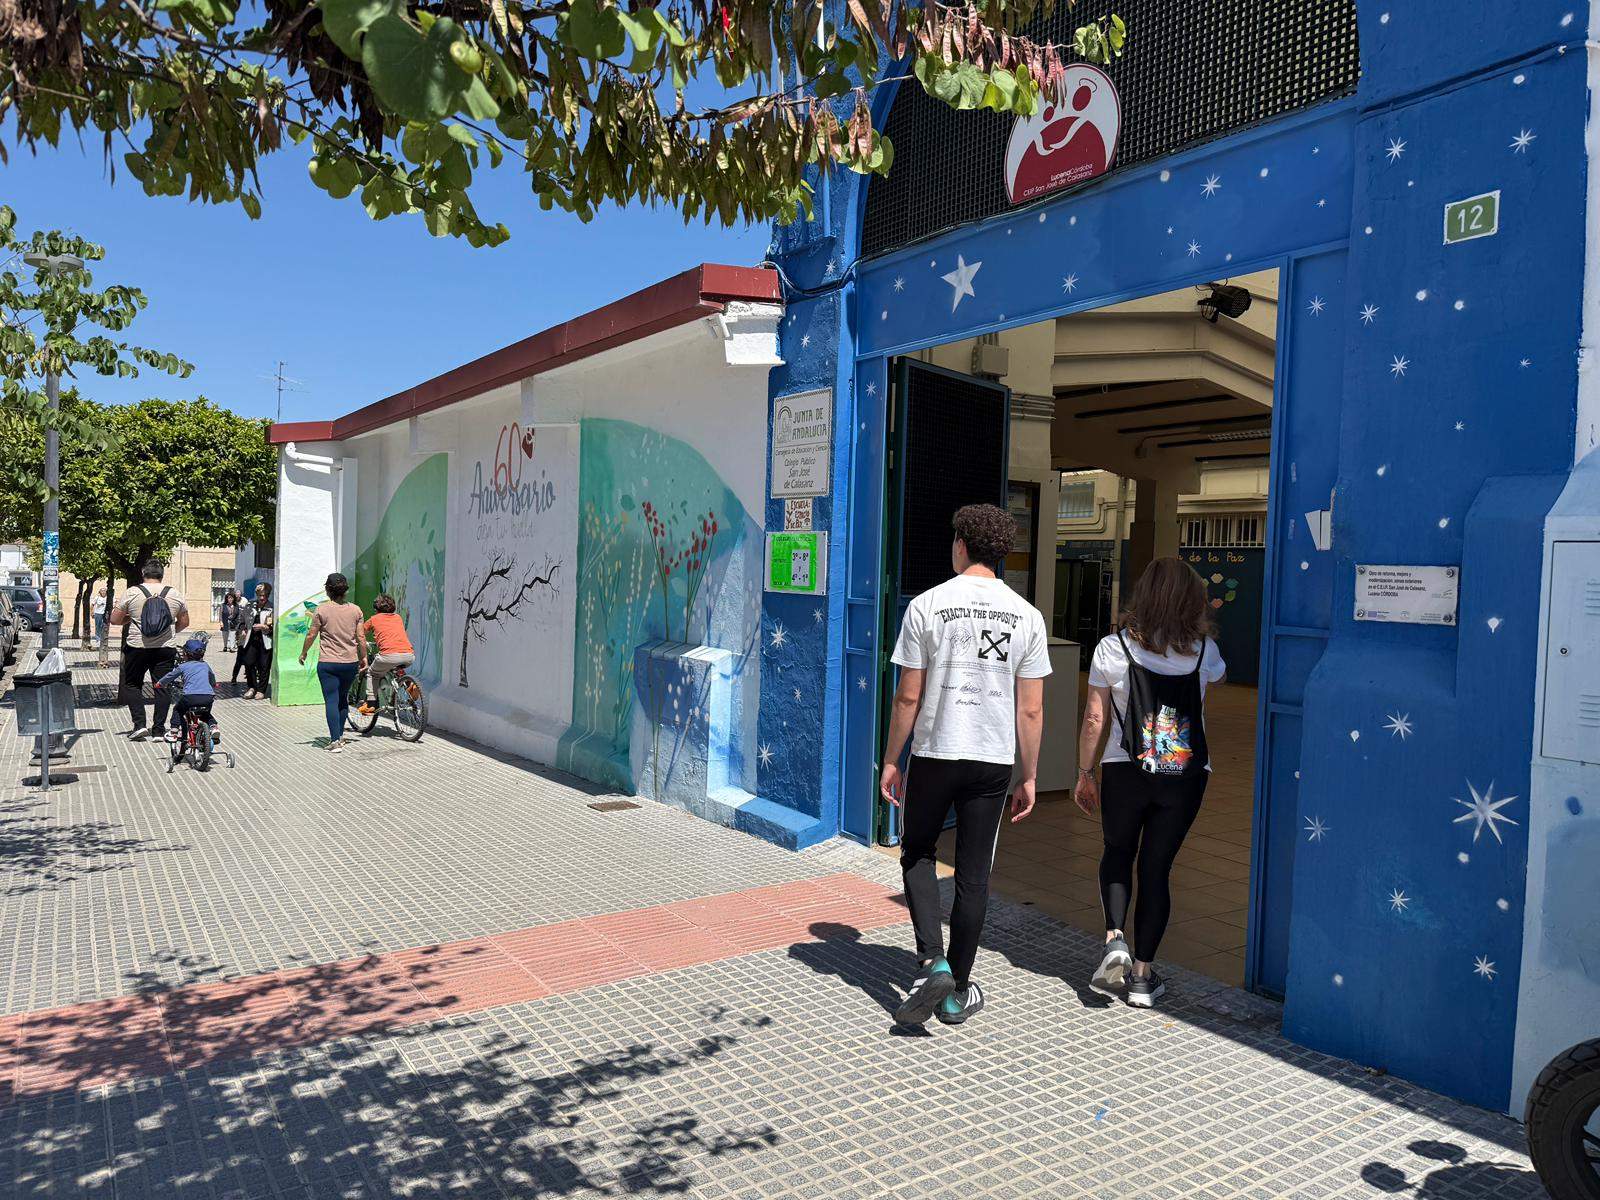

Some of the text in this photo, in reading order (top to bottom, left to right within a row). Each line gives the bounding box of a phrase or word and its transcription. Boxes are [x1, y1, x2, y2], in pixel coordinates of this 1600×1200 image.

[1458, 204, 1484, 233] 12
[793, 407, 824, 423] JUNTA DE
[494, 422, 522, 497] 60
[788, 467, 799, 478] San
[468, 460, 556, 519] Aniversario
[784, 479, 815, 489] de Calasanz
[1189, 552, 1202, 562] de
[1208, 552, 1220, 562] la
[1227, 551, 1245, 563] Paz
[973, 609, 988, 619] THE
[1156, 763, 1184, 771] Lucena
